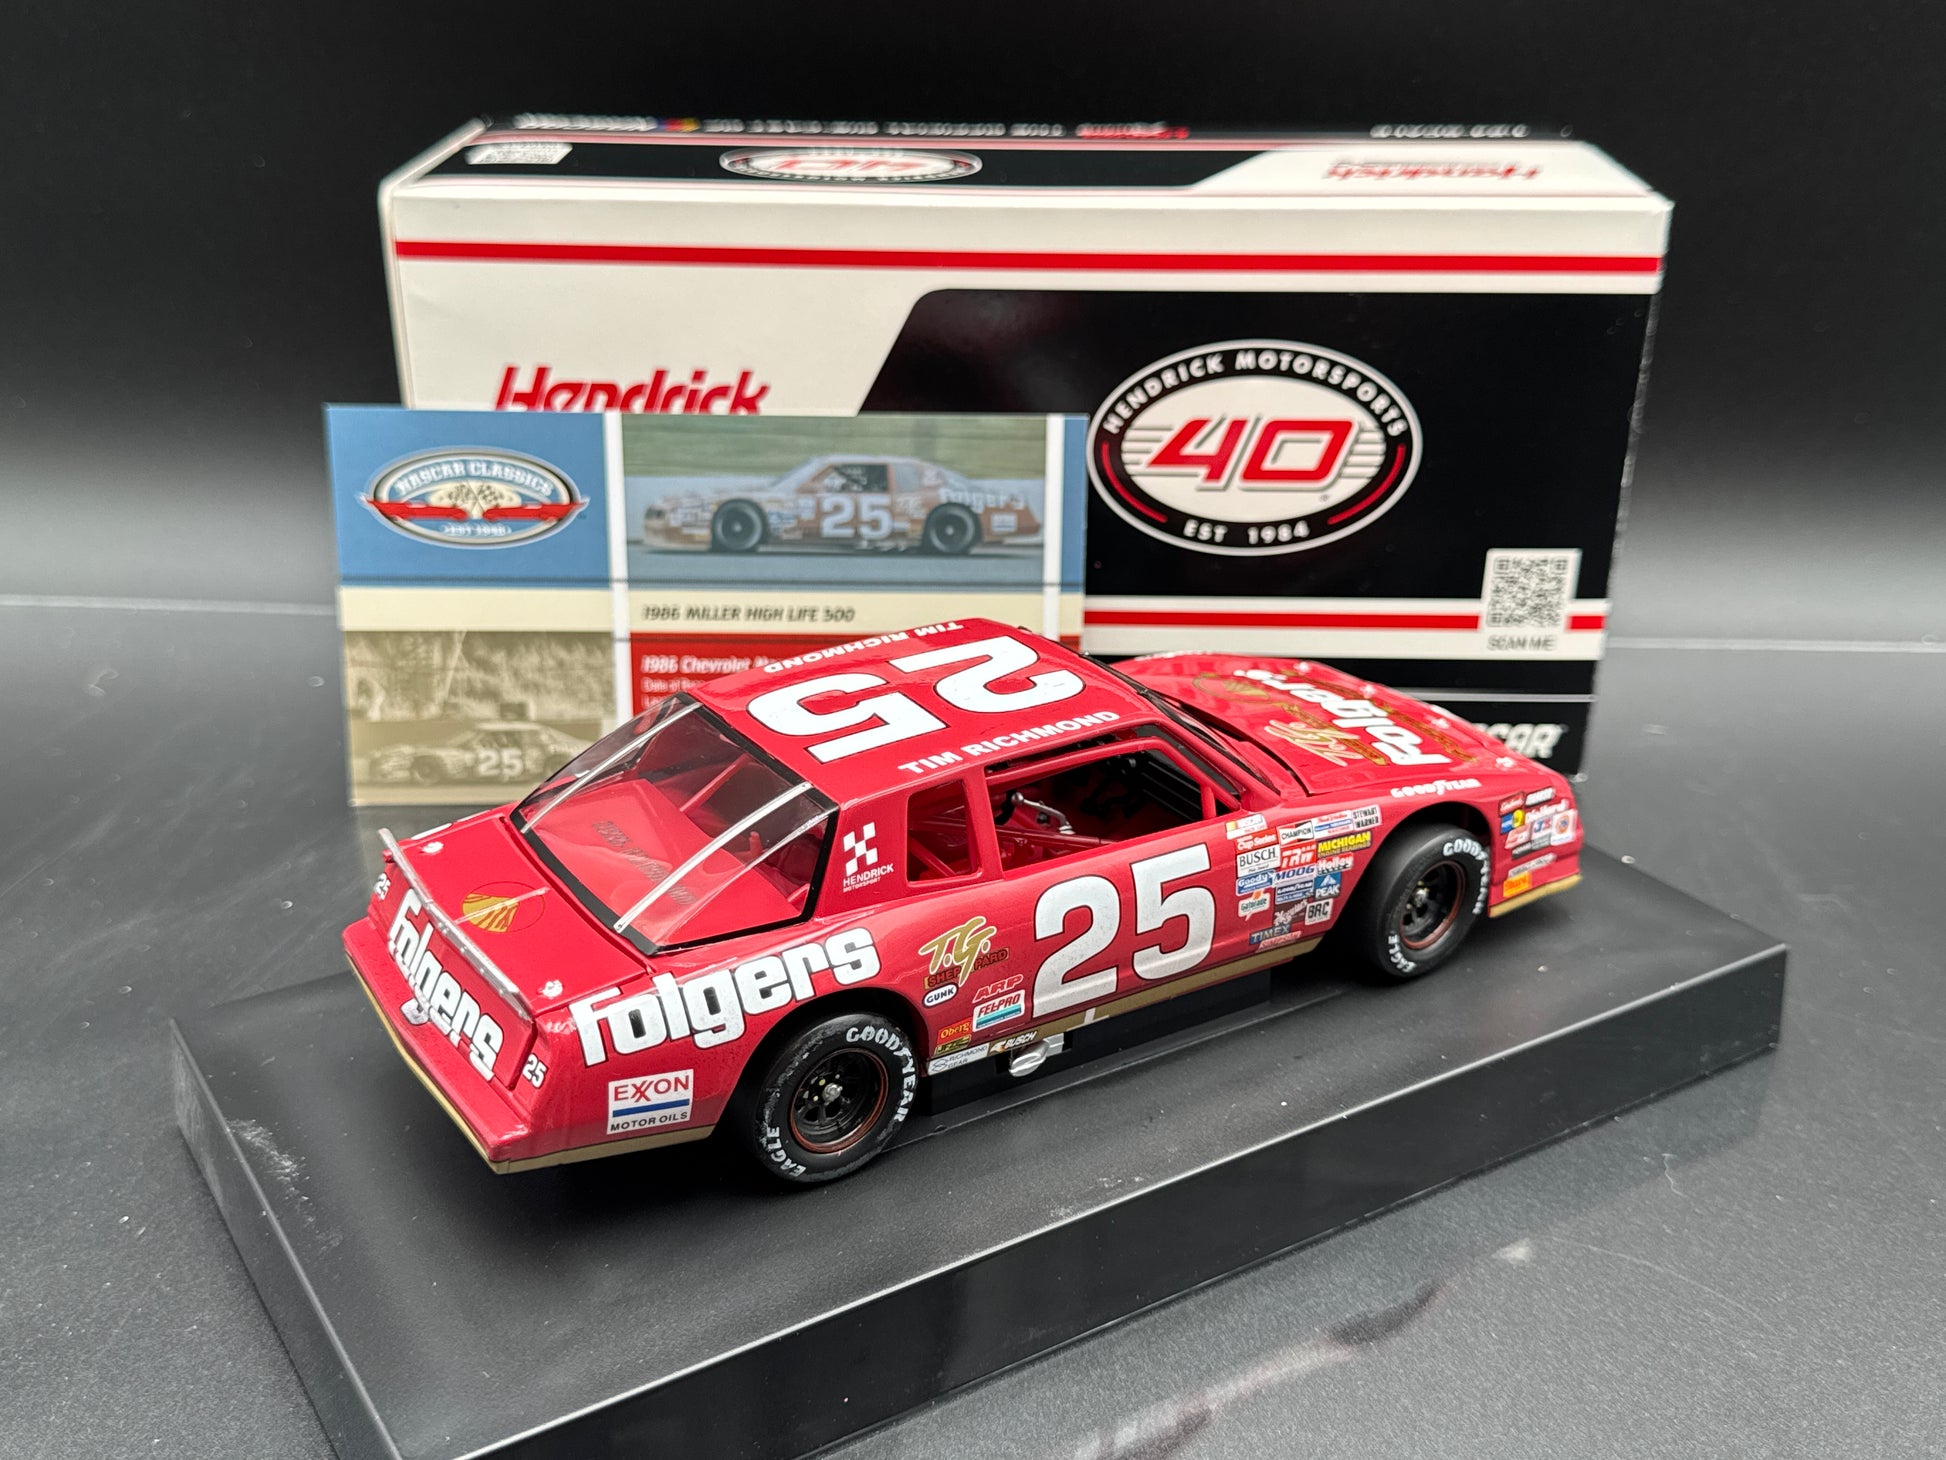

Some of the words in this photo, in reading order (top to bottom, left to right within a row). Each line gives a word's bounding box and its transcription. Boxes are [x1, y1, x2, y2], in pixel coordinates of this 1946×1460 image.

[1100, 350, 1226, 437] HENDRICK
[1233, 348, 1408, 438] MOTORSPORTS
[1147, 417, 1356, 484] 40
[394, 461, 466, 496] NASCAR
[467, 461, 555, 497] CLASSICS
[820, 496, 893, 540] 25
[1183, 518, 1228, 543] EST
[1247, 521, 1310, 546] 1984
[643, 605, 681, 621] 1986
[685, 606, 741, 621] MILLER
[744, 606, 784, 622] HIGH
[787, 607, 819, 623] LIFE
[822, 608, 856, 623] 500
[914, 620, 965, 638] TIM
[763, 629, 909, 674] RICHMOND
[1487, 635, 1527, 651] SCAN
[1528, 635, 1557, 651] ME
[642, 655, 679, 674] 1986
[745, 634, 1086, 765] 25
[898, 749, 963, 775] TIM
[960, 710, 1121, 758] RICHMOND
[477, 750, 524, 777] 25
[1352, 807, 1378, 819] STEWART
[1354, 816, 1379, 828] WARNER
[1281, 827, 1312, 840] CHAMPION
[1318, 830, 1371, 853] MICHIGAN
[1238, 847, 1276, 867] BUSCH
[843, 863, 895, 887] HENDRICK
[1274, 865, 1315, 881] MOOG
[1315, 884, 1340, 899] PEAK
[1308, 901, 1330, 919] BRC
[1032, 842, 1217, 1020] 25
[1251, 925, 1290, 943] TIMEX
[387, 887, 504, 1082] Folgers
[568, 926, 882, 1067] Folgers
[926, 988, 955, 1004] GUNK
[971, 973, 1024, 1004] ARP
[940, 1021, 971, 1039] Oberg
[1004, 1031, 1038, 1049] BUSCH
[522, 1053, 548, 1088] 25
[845, 1025, 917, 1123] GOODYEAR
[613, 1074, 690, 1104] EXXON
[610, 1117, 656, 1132] MOTOR
[659, 1111, 689, 1123] OILS
[761, 1126, 807, 1178] EAGLE
